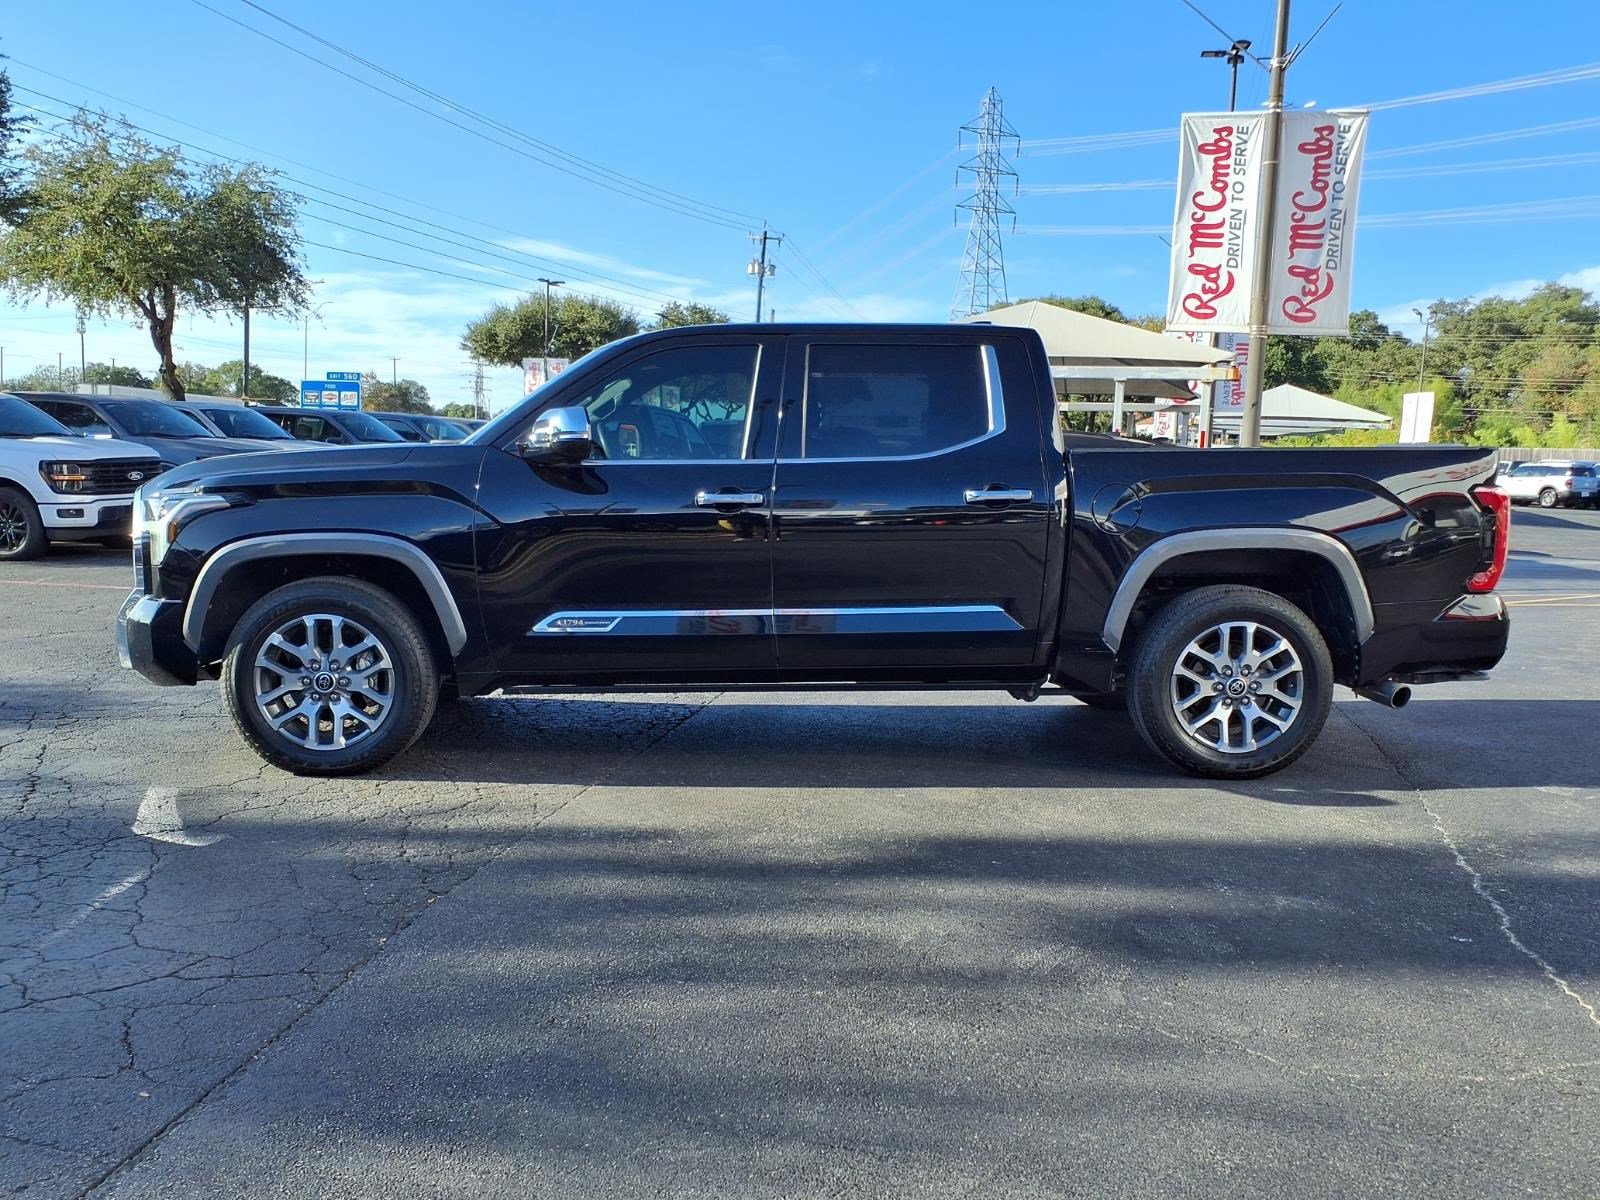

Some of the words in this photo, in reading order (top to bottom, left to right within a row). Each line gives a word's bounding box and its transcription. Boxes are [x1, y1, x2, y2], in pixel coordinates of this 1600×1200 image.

[1233, 125, 1249, 177] SERVE
[1334, 123, 1351, 176] SERVE
[1188, 125, 1233, 258] McCombs
[1231, 184, 1245, 203] TO
[1287, 124, 1335, 260] McCombs
[1331, 183, 1346, 204] TO
[1226, 208, 1243, 269] DRIVEN
[1325, 208, 1343, 271] DRIVEN
[1182, 263, 1235, 320] Red
[1282, 265, 1334, 323] Red
